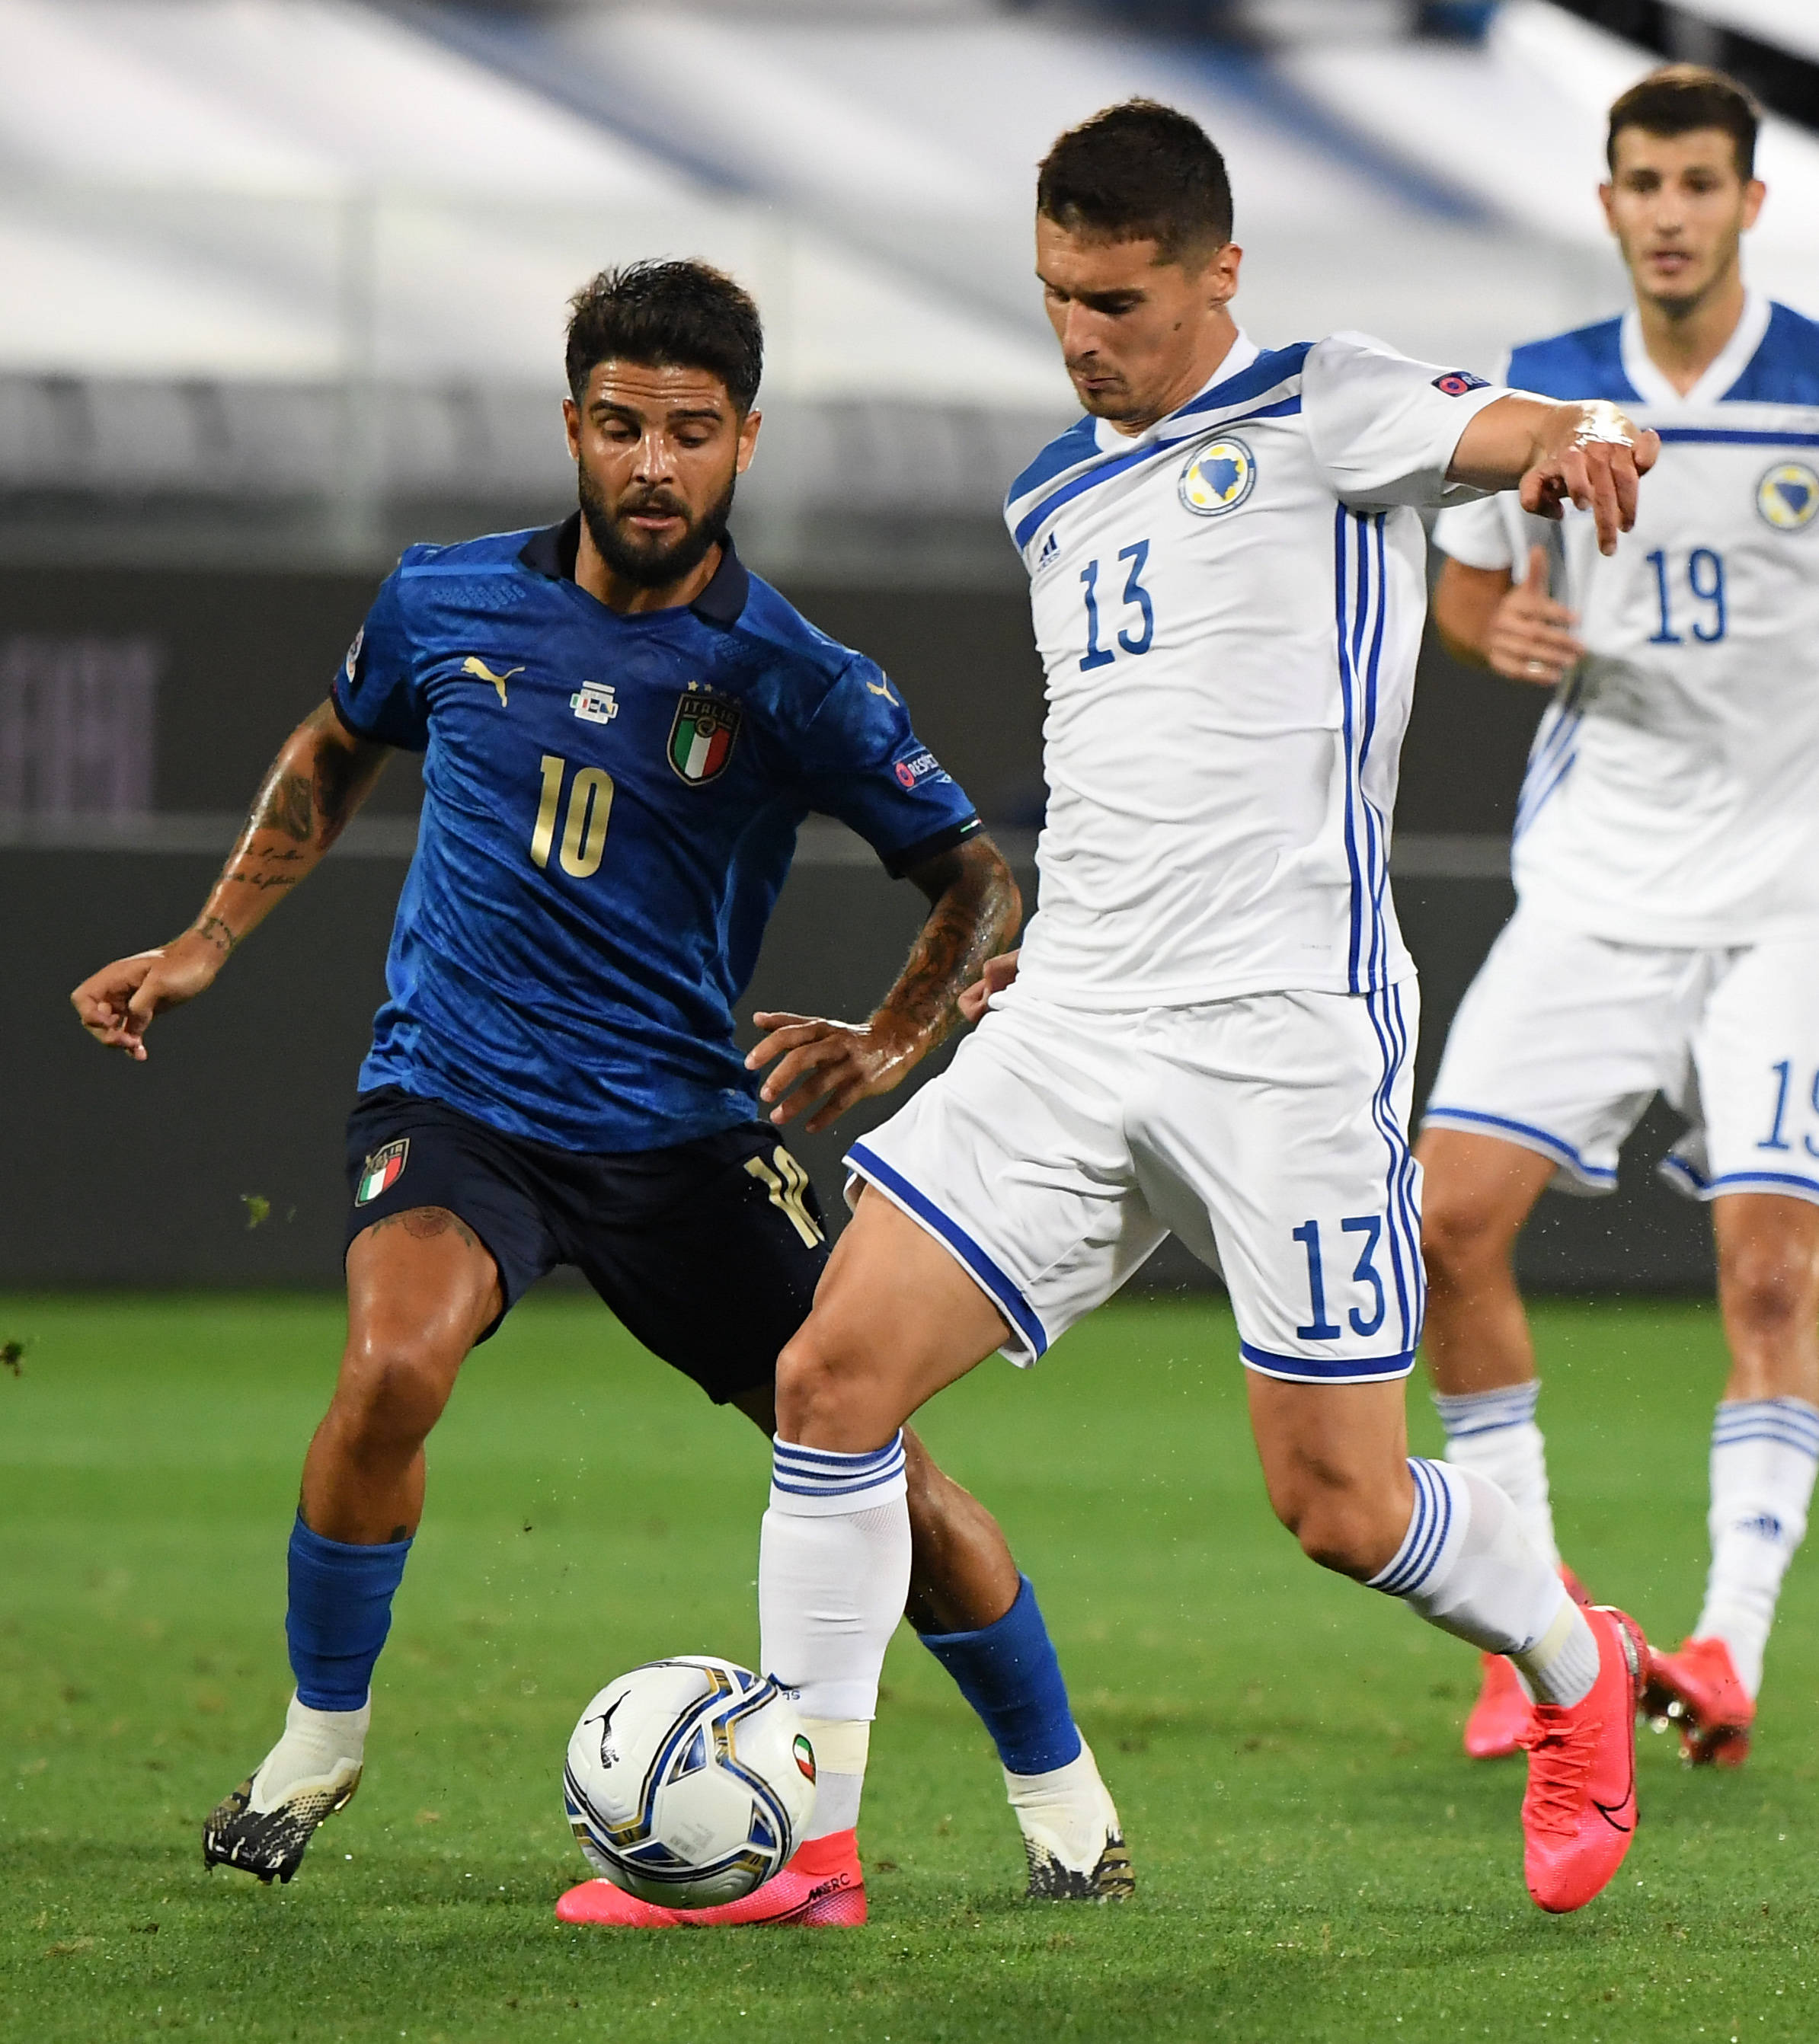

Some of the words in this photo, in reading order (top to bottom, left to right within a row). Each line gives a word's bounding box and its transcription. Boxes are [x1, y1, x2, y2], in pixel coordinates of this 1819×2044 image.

[1079, 538, 1154, 672] 13
[1647, 548, 1725, 643] 19
[530, 755, 614, 878] 10
[743, 1145, 826, 1249] 10
[1293, 1215, 1385, 1340] 13
